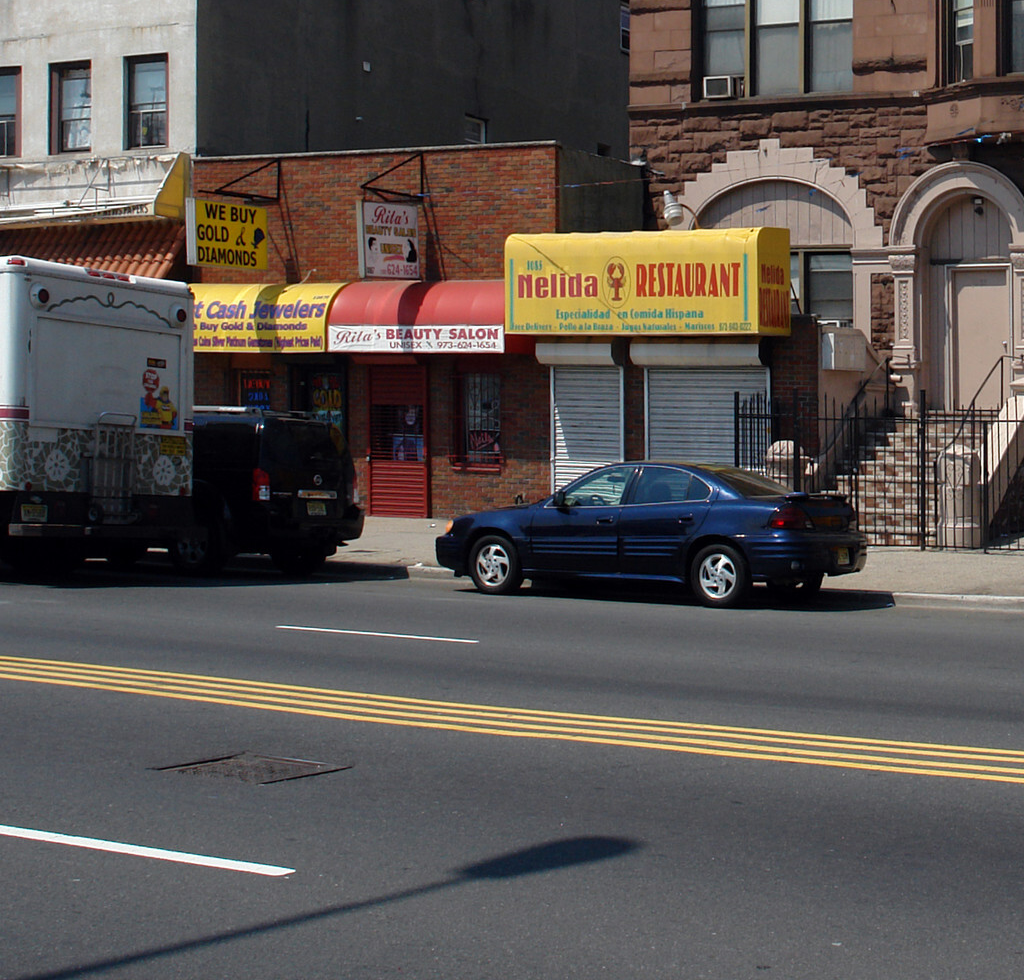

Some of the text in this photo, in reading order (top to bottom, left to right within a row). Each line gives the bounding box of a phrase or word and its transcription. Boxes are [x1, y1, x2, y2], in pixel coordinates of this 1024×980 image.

[205, 203, 257, 224] WE BUY
[372, 205, 409, 225] Rita's
[197, 224, 246, 246] GOLD &
[197, 246, 257, 267] DIAMONDS
[636, 262, 741, 298] RESTAURANT
[761, 263, 785, 286] Nelida
[517, 273, 598, 299] Nelida
[206, 300, 247, 320] Cash
[249, 299, 326, 320] Jewelers
[555, 308, 704, 321] Especialidad en Comida Hispana
[200, 322, 219, 332] Buy
[221, 321, 244, 331] Gold
[246, 322, 254, 331] &
[256, 321, 308, 331] Diamonds
[333, 328, 499, 344] Rita's BEAUTY SALON
[559, 322, 577, 331] Pollo
[684, 322, 715, 331] Mariscos
[389, 341, 497, 349] UNISEX 973-624-1654
